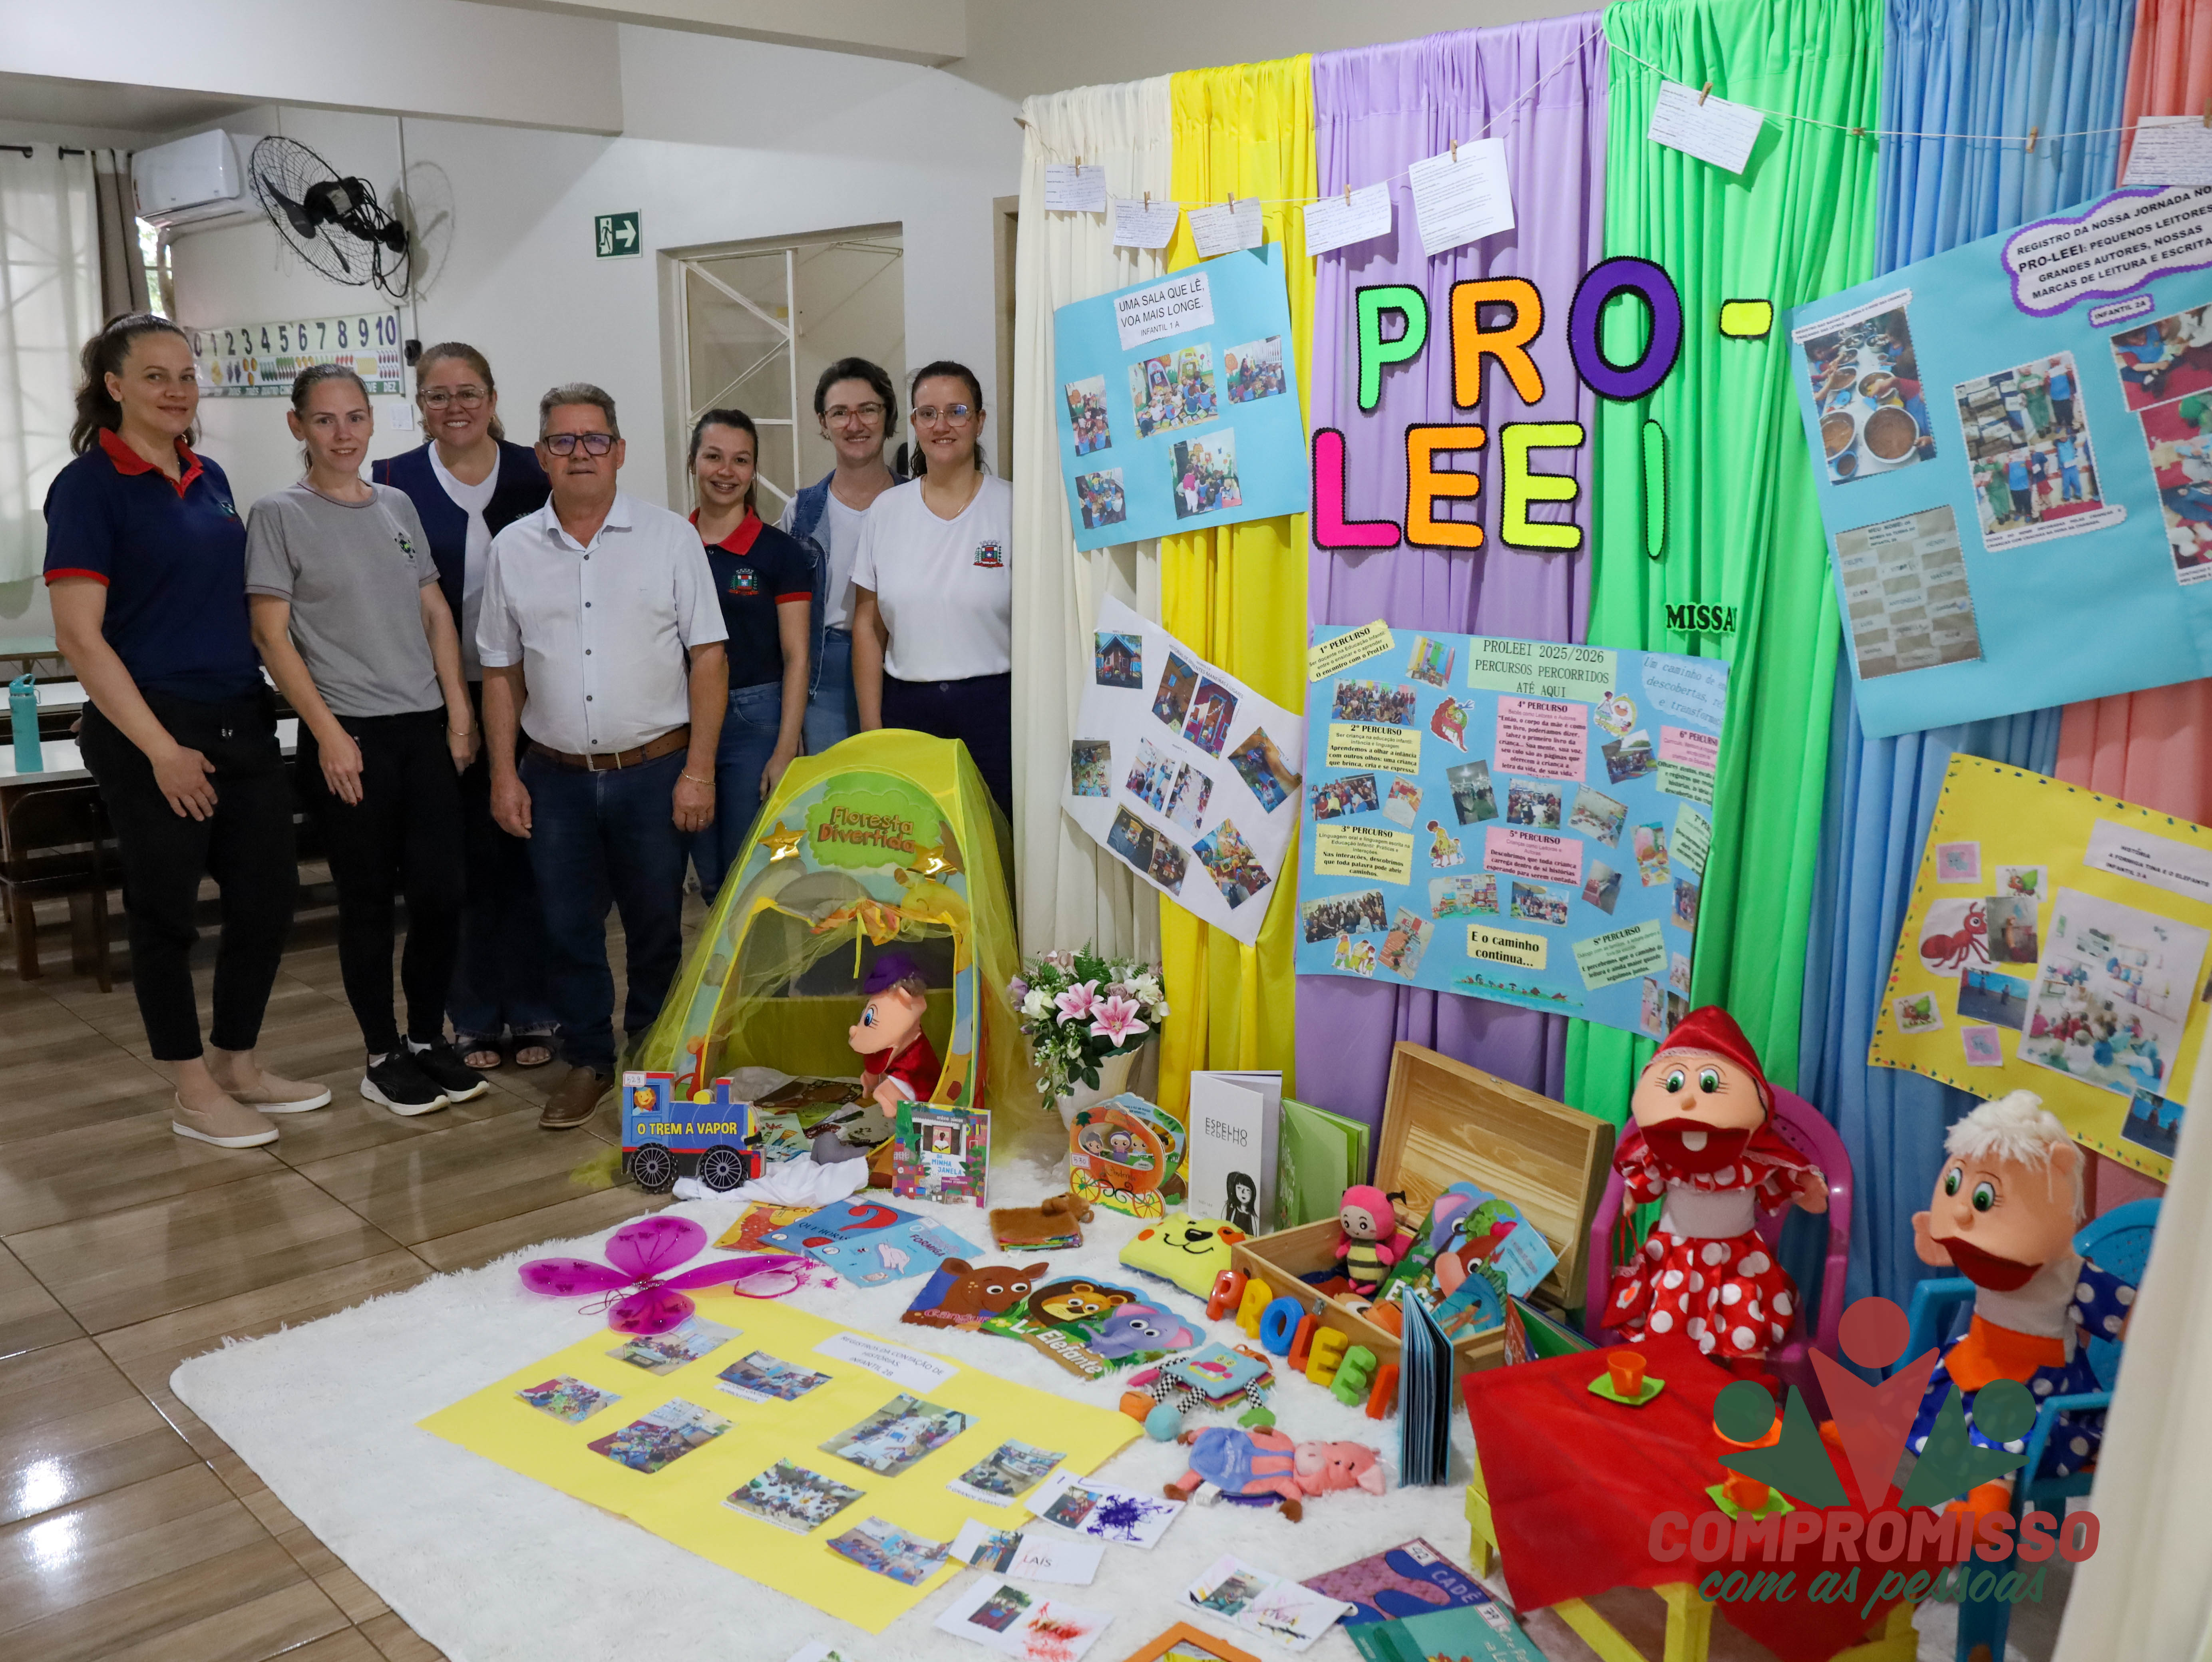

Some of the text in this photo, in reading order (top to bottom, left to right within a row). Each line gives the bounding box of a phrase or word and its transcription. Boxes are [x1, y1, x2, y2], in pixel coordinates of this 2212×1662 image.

[2018, 232, 2071, 255] REGISTRO
[2074, 226, 2089, 237] DA
[2092, 213, 2130, 231] NOSSA
[2134, 193, 2191, 217] JORNADA
[2090, 225, 2152, 250] PEQUENOS
[2039, 225, 2203, 282] GRANDES AUTORES, NOSSAS
[2032, 280, 2077, 299] MARCAS
[2081, 274, 2095, 284] DE
[2099, 258, 2147, 279] LEITURA
[1120, 278, 1204, 312] UMA SALA QUE LÊ,
[1121, 298, 1203, 328] VOA MAIS LONGE.
[2095, 304, 2132, 319] INFANTIL
[211, 334, 217, 356] 1
[226, 332, 236, 356] 2
[242, 328, 253, 355] 3
[261, 327, 270, 353] 4
[279, 325, 288, 352] 5
[298, 324, 307, 351] 6
[316, 322, 326, 349] 7
[338, 320, 348, 348] 8
[359, 318, 368, 347] 9
[376, 315, 396, 346] 10
[1141, 325, 1168, 336] INFANTIL
[384, 382, 396, 392] DEZ
[1666, 604, 1737, 632] MISSA
[1318, 652, 1337, 663] docente
[1345, 638, 1368, 650] Educação
[1369, 631, 1386, 642] Infantil:
[1329, 628, 1370, 650] PERCURSO
[1335, 652, 1353, 662] ensinar
[1362, 639, 1382, 651] aprender
[1323, 662, 1347, 676] encontro
[1349, 656, 1361, 664] com
[1367, 643, 1388, 656] ProLEEI
[1483, 640, 1604, 663] PROLEEI 2025/2026
[1475, 660, 1609, 684] PERCURSOS PERCORRIDOS
[1663, 664, 1702, 680] caminho
[1706, 674, 1715, 685] de
[1517, 682, 1566, 698] ATÉ AQUI
[1647, 676, 1707, 702] descobertas,
[1528, 702, 1567, 712] PERCURSO
[1362, 726, 1401, 736] PERCURSO
[830, 805, 914, 835] Floresta
[818, 823, 915, 853] Divertida
[1353, 827, 1392, 838] PERCURSO
[1520, 832, 1560, 845] PERCURSO
[1336, 852, 1368, 861] interações,
[1370, 856, 1403, 867] descobrimos
[1472, 931, 1478, 942] E
[1492, 937, 1539, 952] caminho
[1602, 926, 1641, 943] PERCURSO
[1476, 950, 1533, 966] continua...
[637, 1122, 737, 1135] O TREM A VAPOR
[938, 1167, 962, 1175] JANELA
[910, 1235, 945, 1256] FORMIGA
[841, 1336, 879, 1352] REGISTROS
[891, 1350, 933, 1370] CONTAÇÃO
[933, 1367, 944, 1376] DE
[1036, 1330, 1103, 1374] Elefante
[850, 1357, 882, 1371] INFANTIL
[1431, 1570, 1482, 1603] CADÊ
